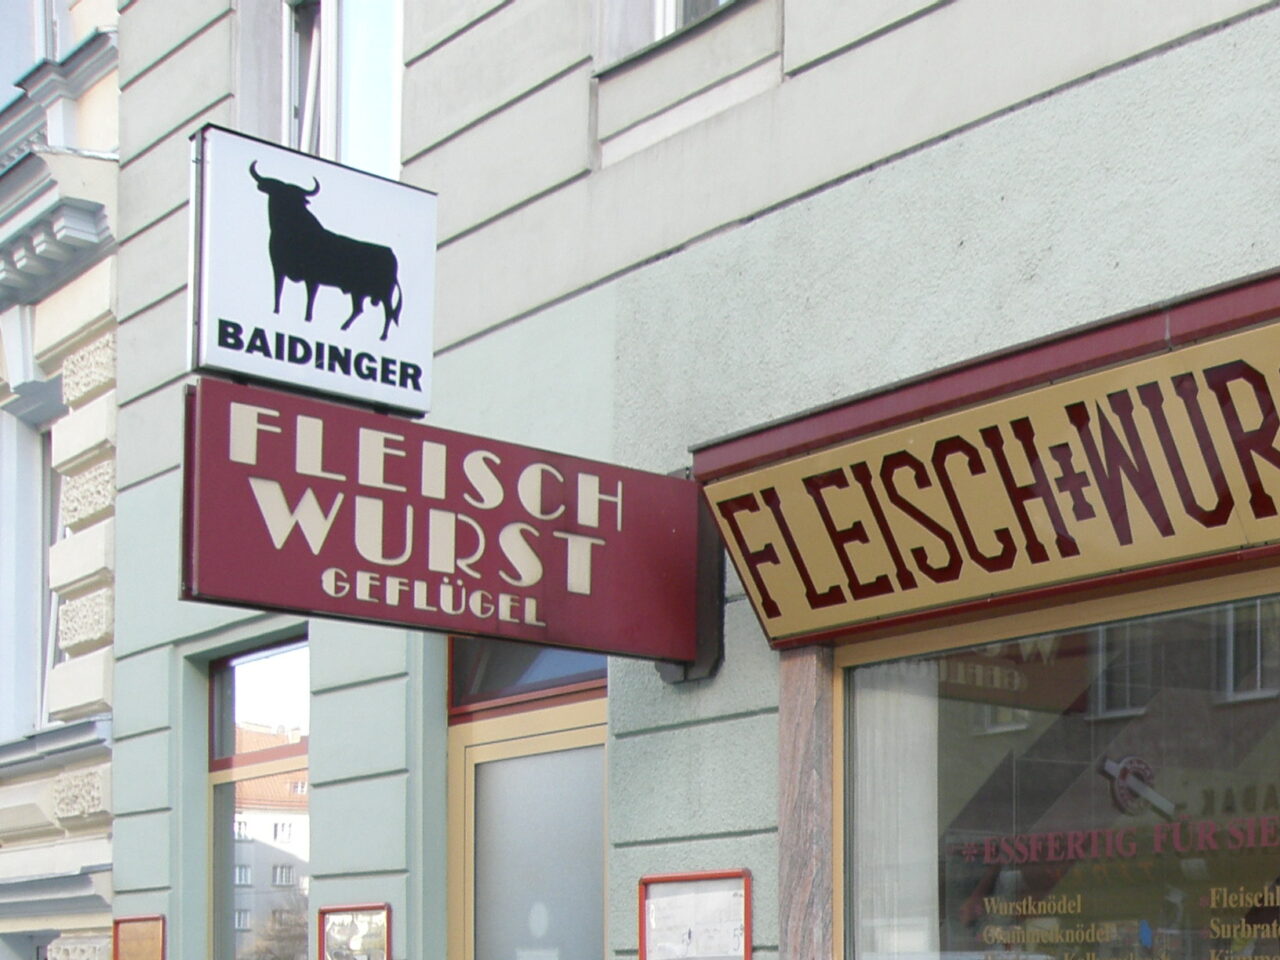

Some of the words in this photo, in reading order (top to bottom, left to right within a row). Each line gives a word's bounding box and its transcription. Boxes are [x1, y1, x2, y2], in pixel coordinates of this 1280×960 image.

[217, 318, 422, 391] BAIDINGER
[229, 402, 622, 531] FLEISCH
[248, 477, 605, 595] WURST
[321, 567, 546, 627] GEFLÜGEL
[984, 827, 1137, 864] ESSFERTIG
[1153, 815, 1218, 854] FÜR
[1228, 816, 1280, 850] SIE
[983, 894, 1082, 916] Wurstknödel
